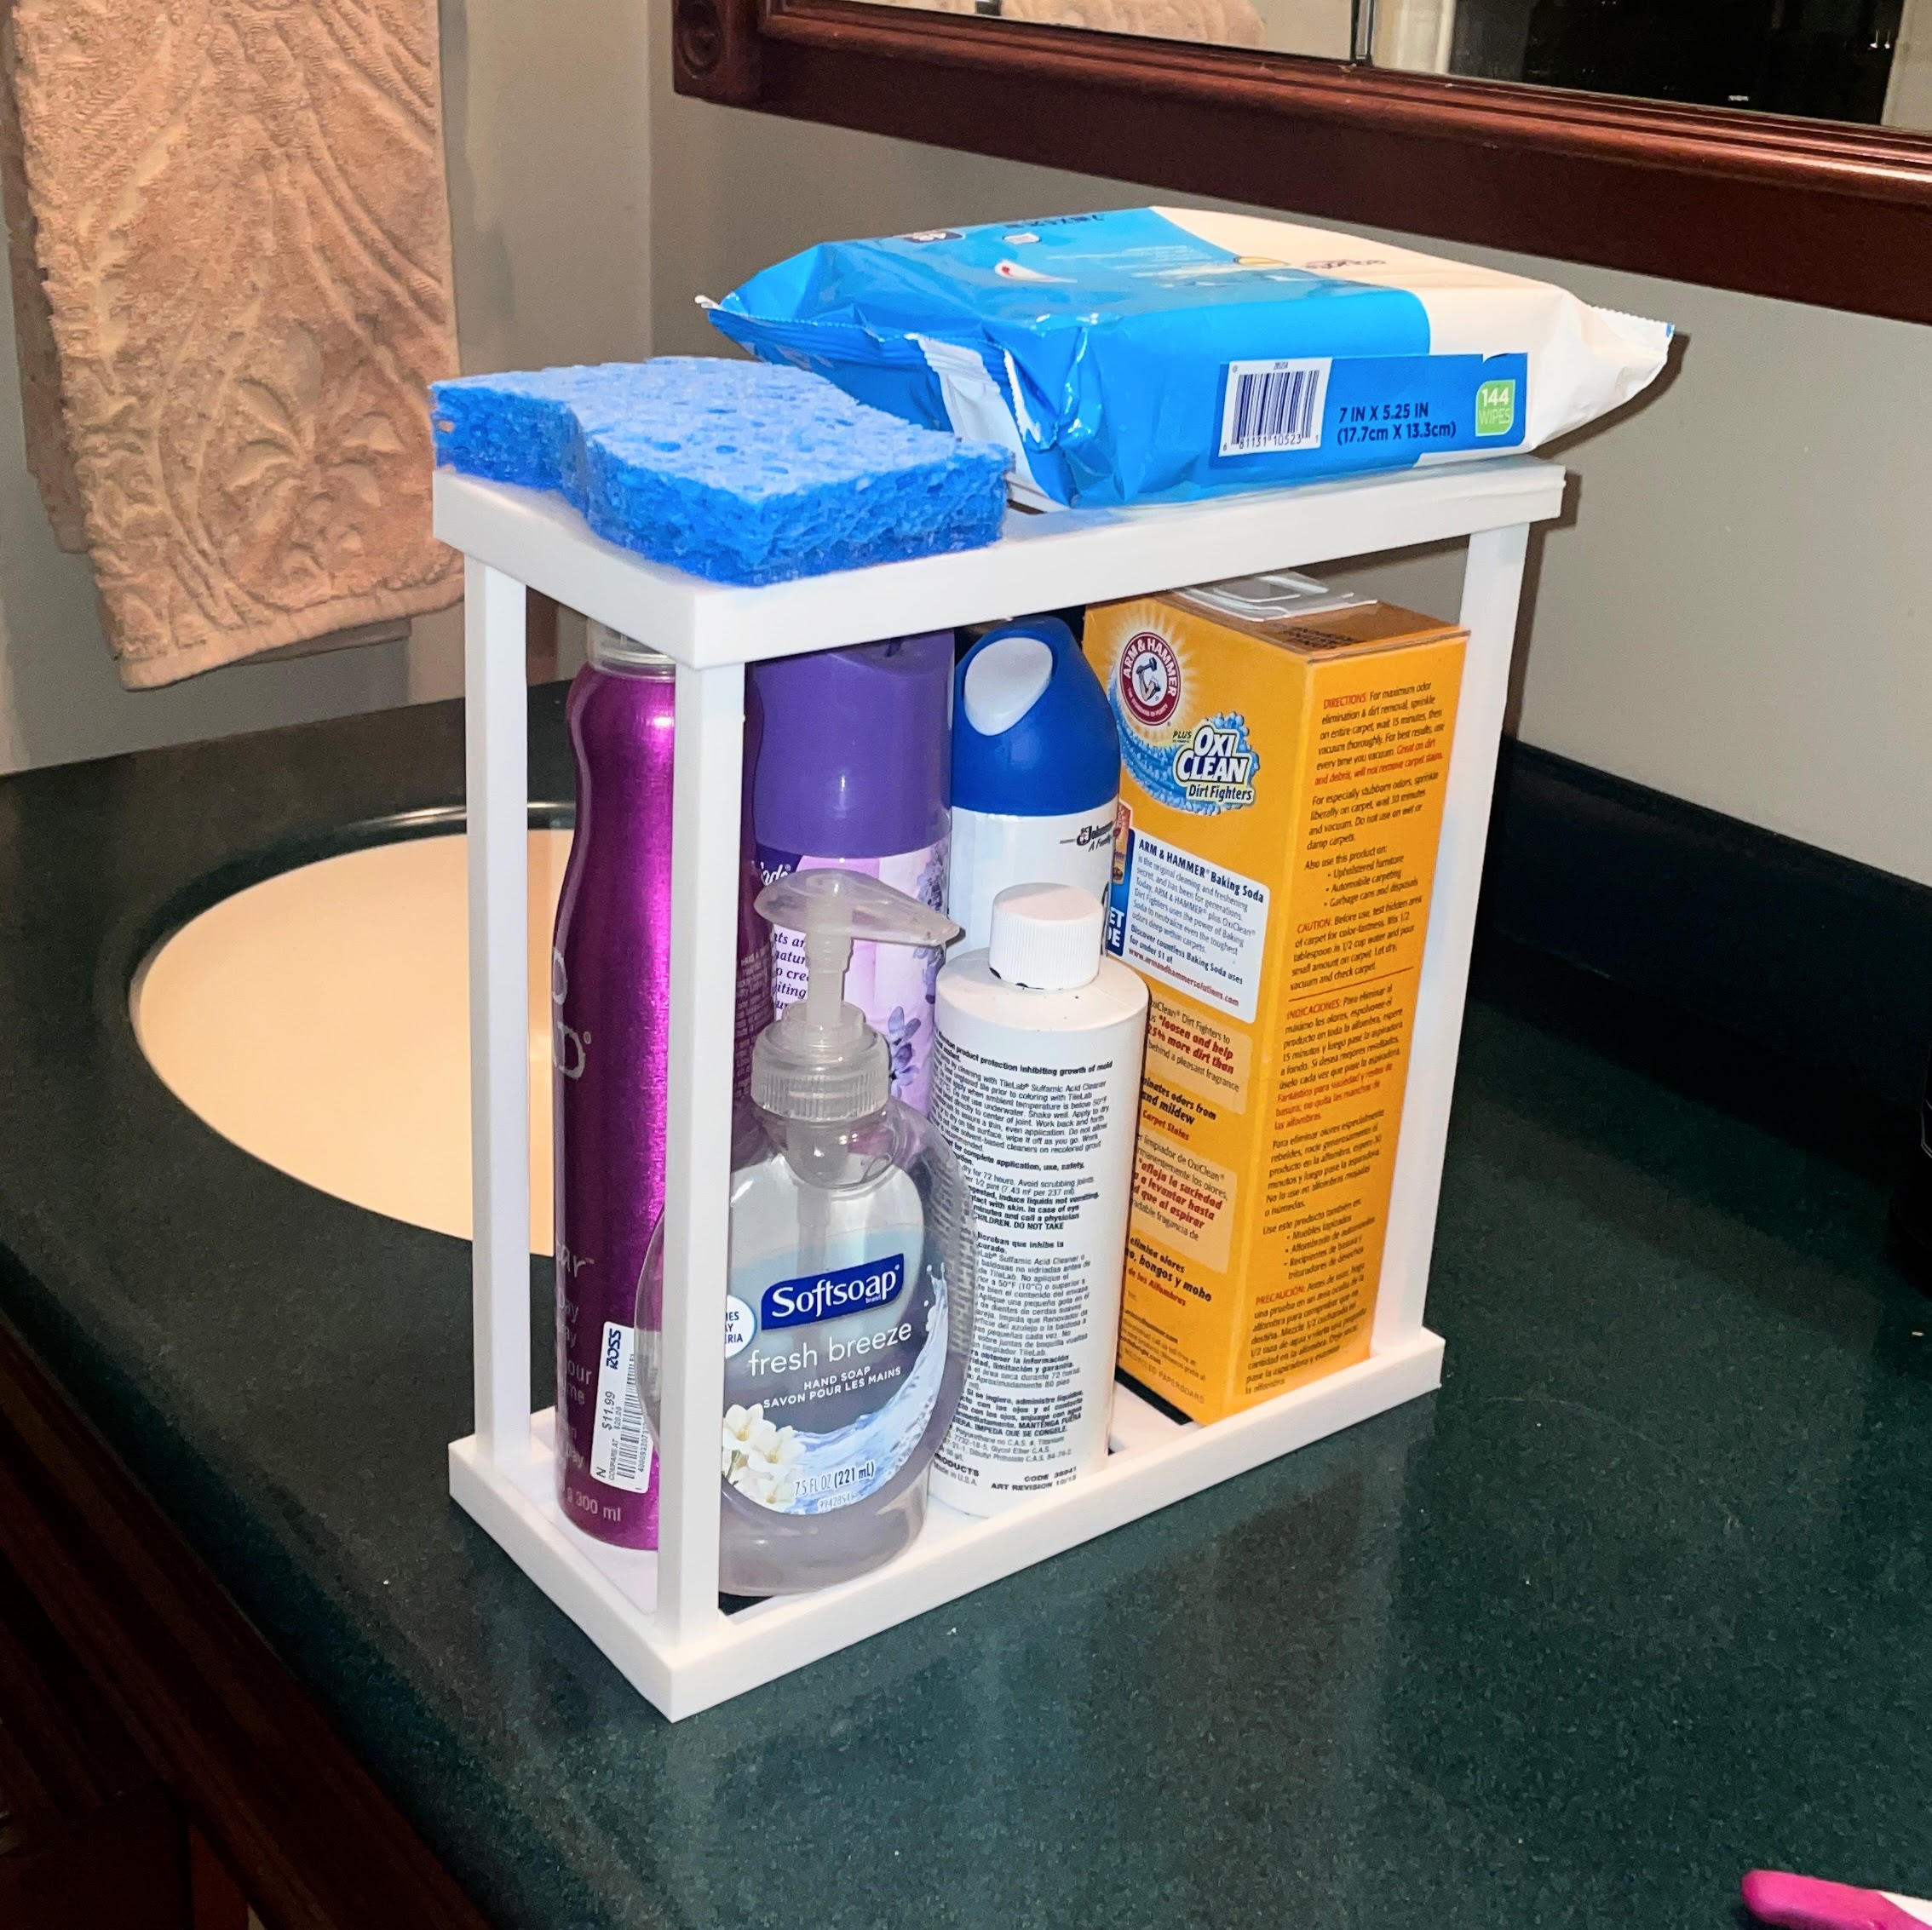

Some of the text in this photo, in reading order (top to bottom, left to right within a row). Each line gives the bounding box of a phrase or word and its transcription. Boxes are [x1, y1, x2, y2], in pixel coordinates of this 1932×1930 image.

[1481, 388, 1509, 406] 144
[1339, 403, 1429, 423] 7 IN X 5.25 IN
[1479, 408, 1510, 425] WIPES
[1274, 434, 1302, 445] 10523
[1337, 421, 1457, 445] (17.7cm X 13.3cm)
[1123, 647, 1139, 679] ARM
[1147, 638, 1178, 698] HAMMER
[1370, 692, 1381, 701] For
[1383, 686, 1415, 698] maximum
[1417, 682, 1432, 692] odor
[1173, 731, 1193, 739] PLUS
[1193, 727, 1236, 758] OXI
[1177, 749, 1250, 784] CLEAN
[1188, 784, 1252, 801] Dirt Fighters
[1307, 840, 1328, 851] damp
[1322, 847, 1376, 867] use this product
[1138, 839, 1157, 856] ARM
[1159, 849, 1164, 860] &
[1210, 871, 1240, 896] Baking
[1243, 886, 1264, 903] Soda
[1153, 862, 1248, 912] original cleaning and freshening
[1155, 874, 1242, 921] and has been for generations.
[1134, 888, 1214, 933] Dirt Fighters uses the power
[1154, 885, 1169, 900] ARM
[1208, 910, 1221, 923] plus
[1132, 912, 1182, 941] odors deep within
[1133, 899, 1238, 956] Soda neutralize even the toughest
[1130, 935, 1157, 955] for under
[1131, 924, 1243, 985] Discover countless Baking Soda uses
[1128, 948, 1239, 1006] www.armandhammersolutions.com
[1182, 1014, 1231, 1044] Dirt Fighters to
[957, 1046, 1085, 1076] product protection inhibiting growth
[1167, 1036, 1233, 1074] more dirt than
[1193, 1035, 1210, 1048] and
[1212, 1043, 1233, 1060] help
[983, 1076, 998, 1085] with
[1082, 1080, 1107, 1091] Cleaner
[1177, 1056, 1239, 1092] pleasant fragrance
[992, 1088, 1008, 1097] prior
[1019, 1093, 1048, 1102] coloring
[1068, 1092, 1092, 1100] TileLab
[1171, 1092, 1216, 1120] odors from
[1143, 1109, 1165, 1129] Carpet
[1159, 1101, 1196, 1125] mildew
[963, 1148, 1041, 1171] complete application,
[994, 1175, 1015, 1186] hours.
[1041, 1178, 1074, 1188] scrubbing
[1141, 1190, 1205, 1229] que aspirar
[1148, 1178, 1215, 1221] levantar hasta
[1181, 1183, 1223, 1210] suciedad
[1027, 1221, 1064, 1230] NOT TAKE
[1139, 1255, 1212, 1302] hongos moho
[772, 1270, 897, 1318] Softsoap
[865, 1295, 882, 1305] brand
[607, 1328, 622, 1370] ROSS
[749, 1323, 912, 1376] fresh breeze
[763, 1367, 901, 1409] SAVON POUR LES MAINS
[804, 1366, 871, 1390] HAND SOAP
[602, 1391, 615, 1430] $11.99
[596, 1467, 607, 1478] N
[795, 1477, 807, 1497] 7.5
[809, 1475, 819, 1493] FL
[821, 1473, 833, 1491] OZ
[834, 1469, 855, 1489] (221
[1012, 1482, 1053, 1491] REVISION
[1024, 1473, 1049, 1482] CODE
[576, 1491, 620, 1522] 300 ml
